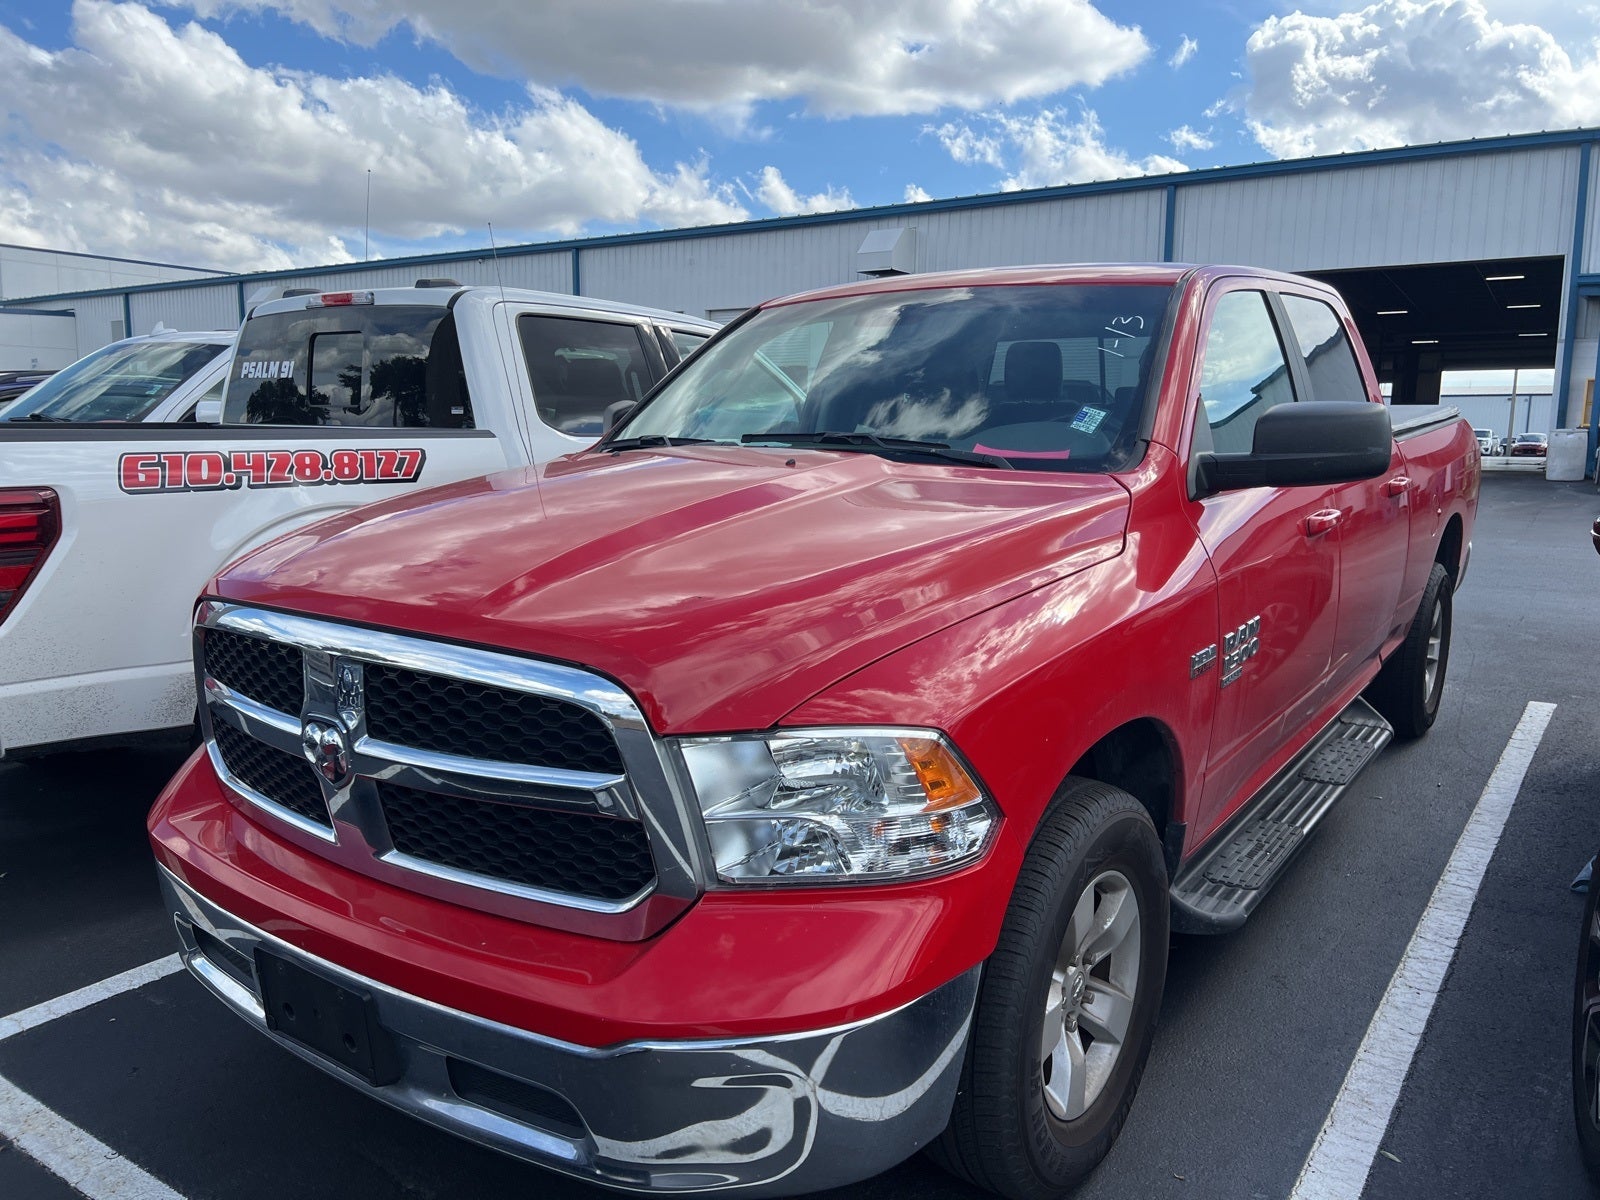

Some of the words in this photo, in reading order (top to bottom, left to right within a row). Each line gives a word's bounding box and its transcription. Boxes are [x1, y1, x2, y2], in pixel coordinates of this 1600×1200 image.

[240, 361, 280, 379] PSALM
[280, 360, 295, 379] 91
[118, 447, 427, 495] 610.428.8127
